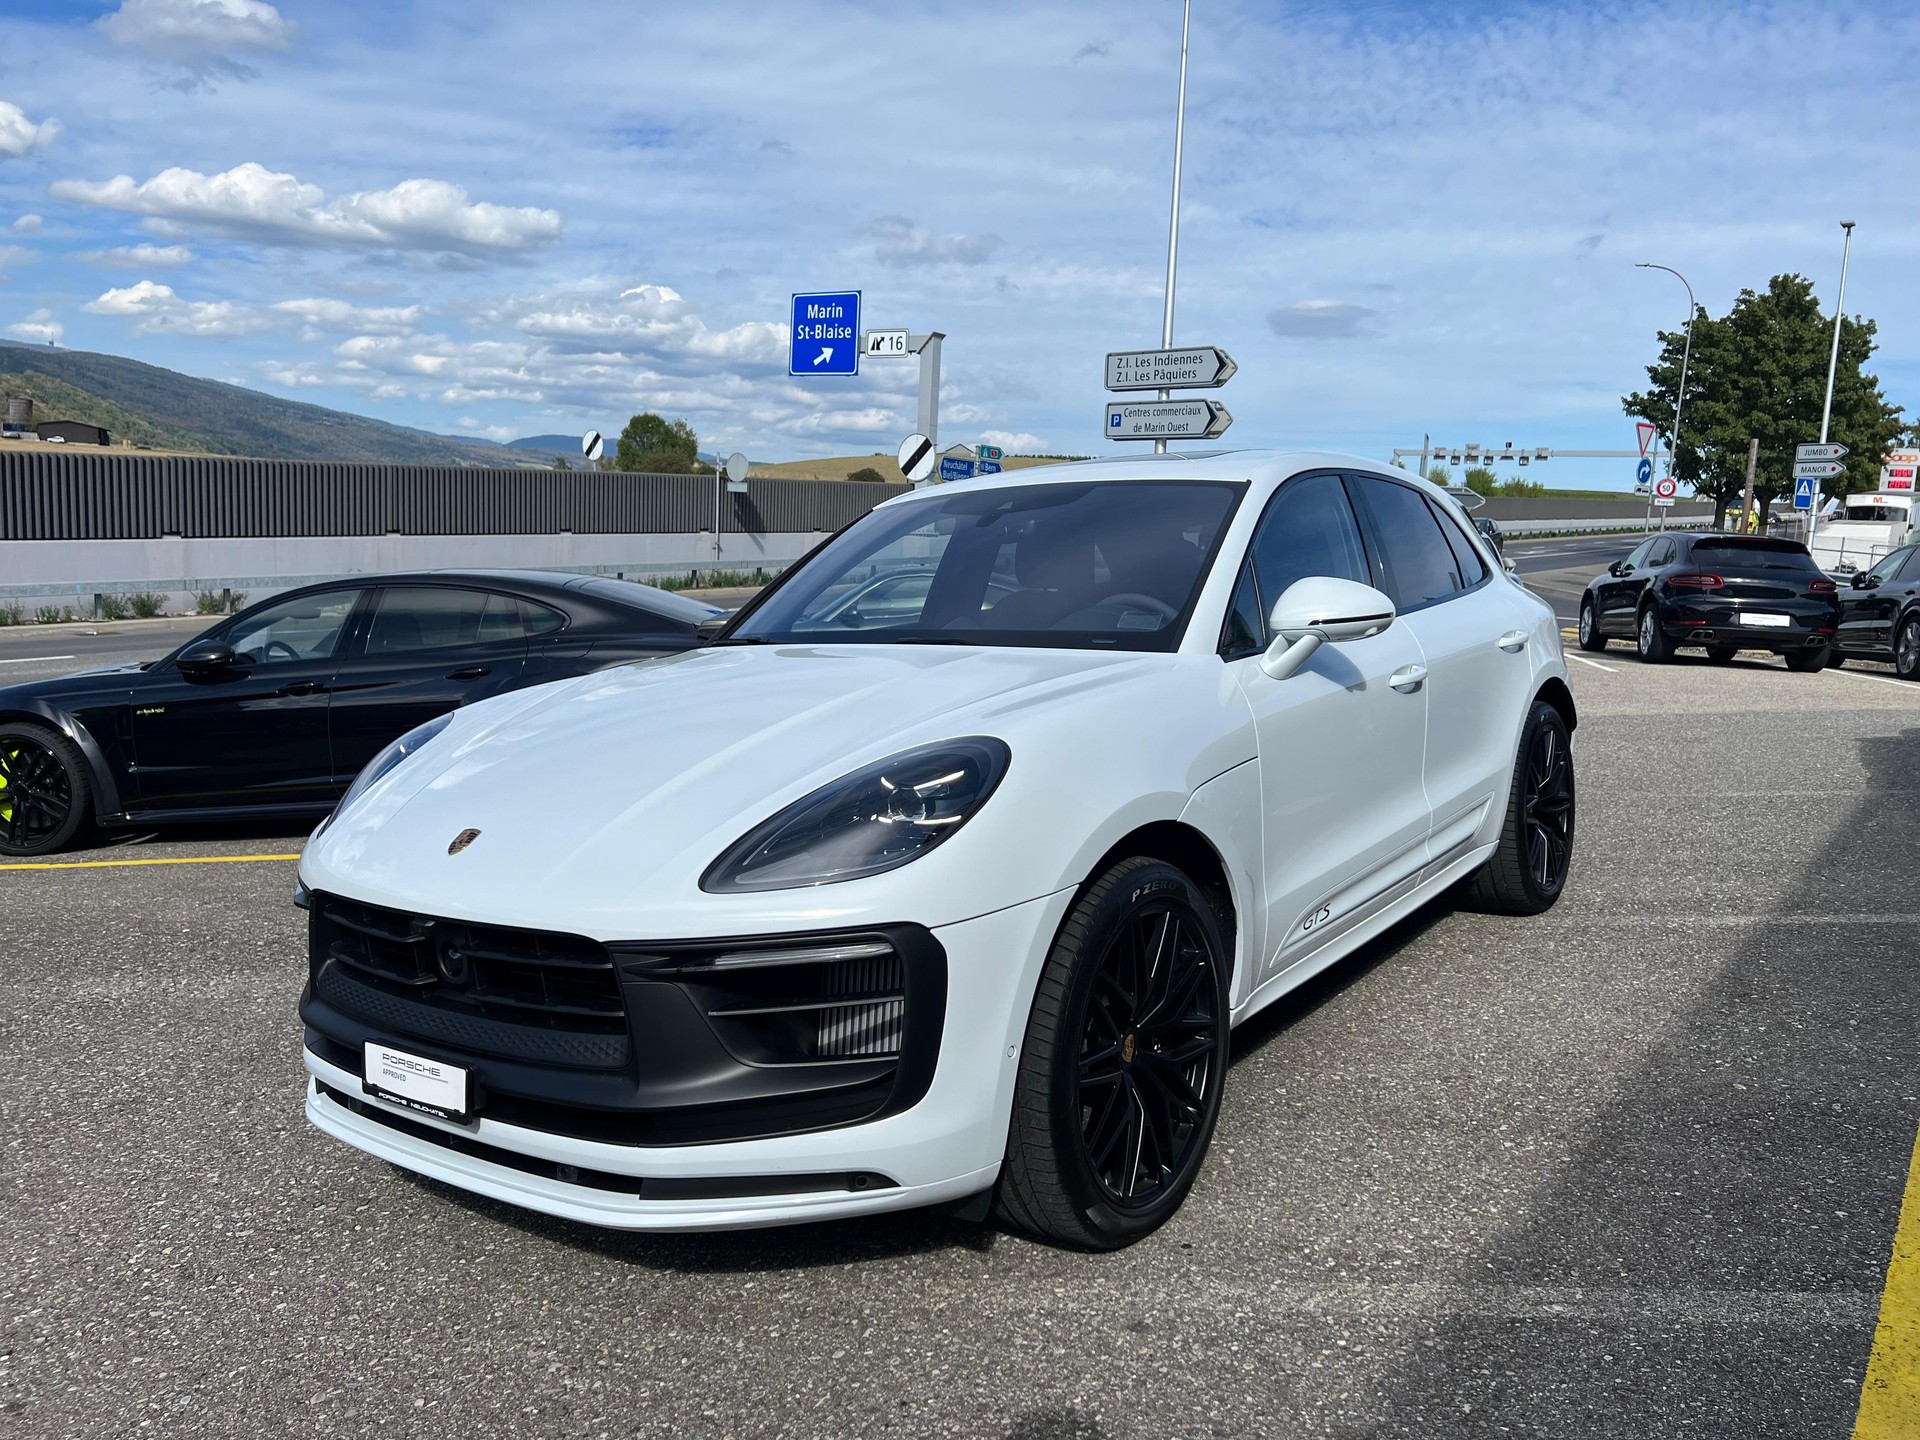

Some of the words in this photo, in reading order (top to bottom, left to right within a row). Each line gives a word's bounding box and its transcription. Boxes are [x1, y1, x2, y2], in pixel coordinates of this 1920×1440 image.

[807, 303, 843, 319] Marin
[797, 323, 852, 340] St-Blaise
[889, 336, 903, 351] 16
[1116, 358, 1132, 369] Z.I.
[1135, 357, 1151, 368] Les
[1154, 354, 1204, 367] Indiennes
[1116, 372, 1131, 383] Z.I.
[1134, 371, 1150, 382] Les
[1153, 369, 1197, 381] Pâquiers
[1123, 407, 1151, 418] Centres
[1152, 405, 1202, 417] commerciaux
[1133, 423, 1142, 433] de
[1144, 422, 1165, 433] Marin
[1167, 422, 1189, 433] Ouest
[1804, 448, 1829, 457] JUMBO
[984, 462, 997, 472] Bern
[1800, 465, 1827, 474] MANOR
[1662, 484, 1671, 492] 50
[1131, 888, 1141, 903] P
[1142, 880, 1178, 895] ZERO
[1303, 902, 1330, 930] GTS
[382, 1053, 441, 1077] PORSCHE
[382, 1068, 407, 1082] APPROVED
[378, 1092, 408, 1106] PORSCHE
